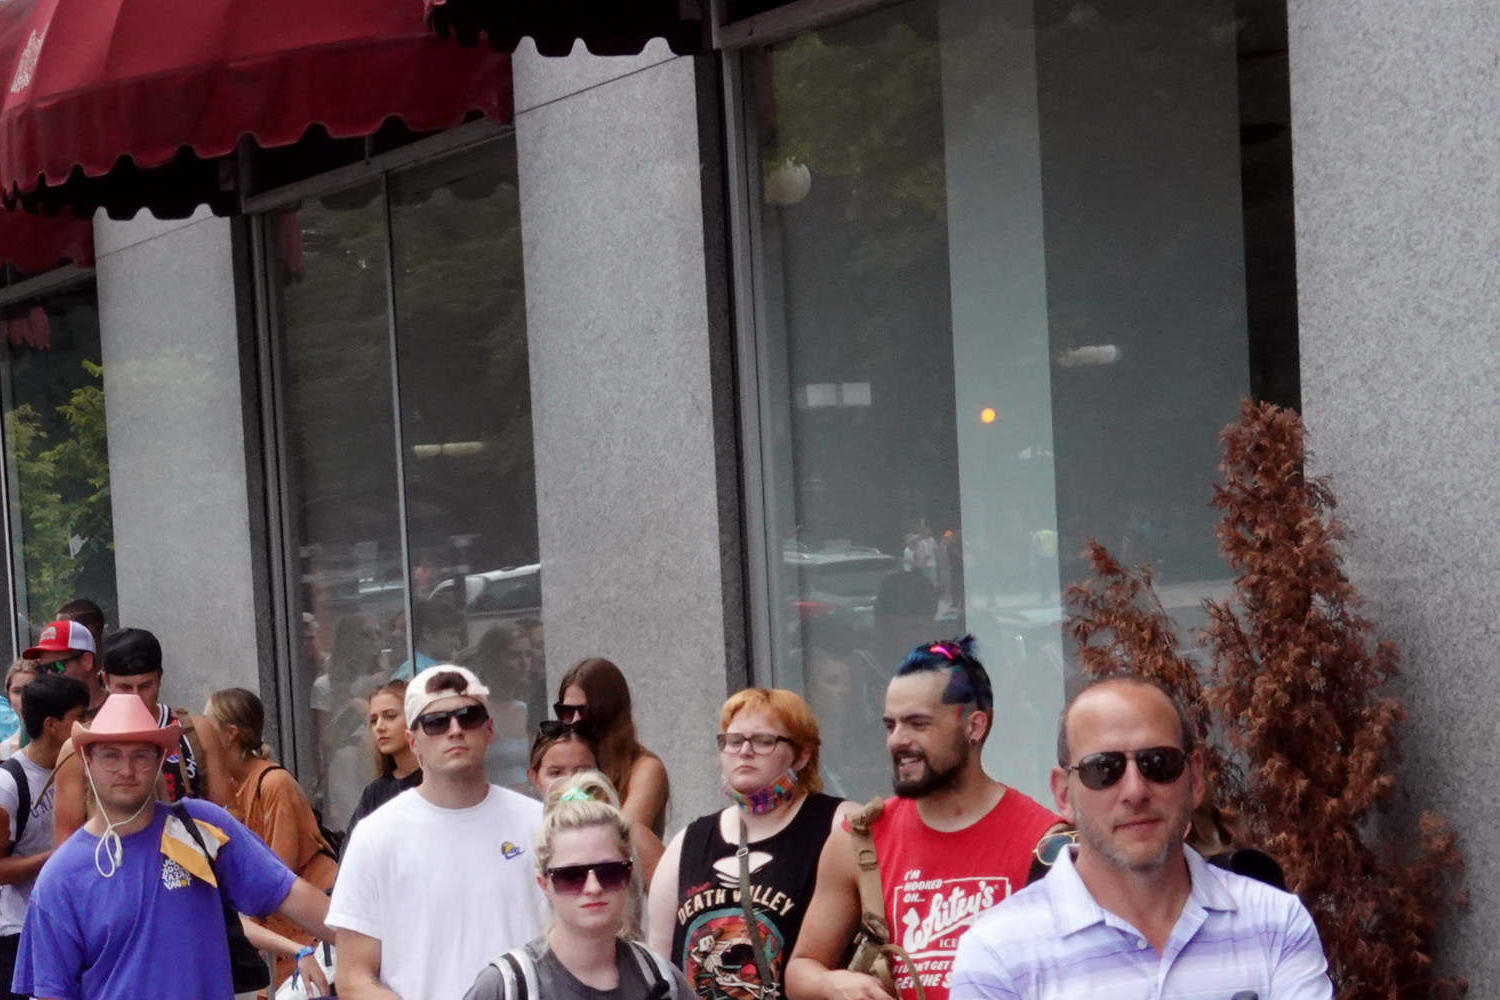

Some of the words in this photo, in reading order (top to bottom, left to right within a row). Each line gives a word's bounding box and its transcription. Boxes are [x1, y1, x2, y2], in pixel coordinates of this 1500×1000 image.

[904, 869, 921, 881] I'M
[903, 879, 943, 892] HOOKED
[677, 888, 727, 926] DEATH
[902, 880, 994, 953] Whitey's
[939, 938, 958, 949] ICE
[930, 960, 951, 971] GET
